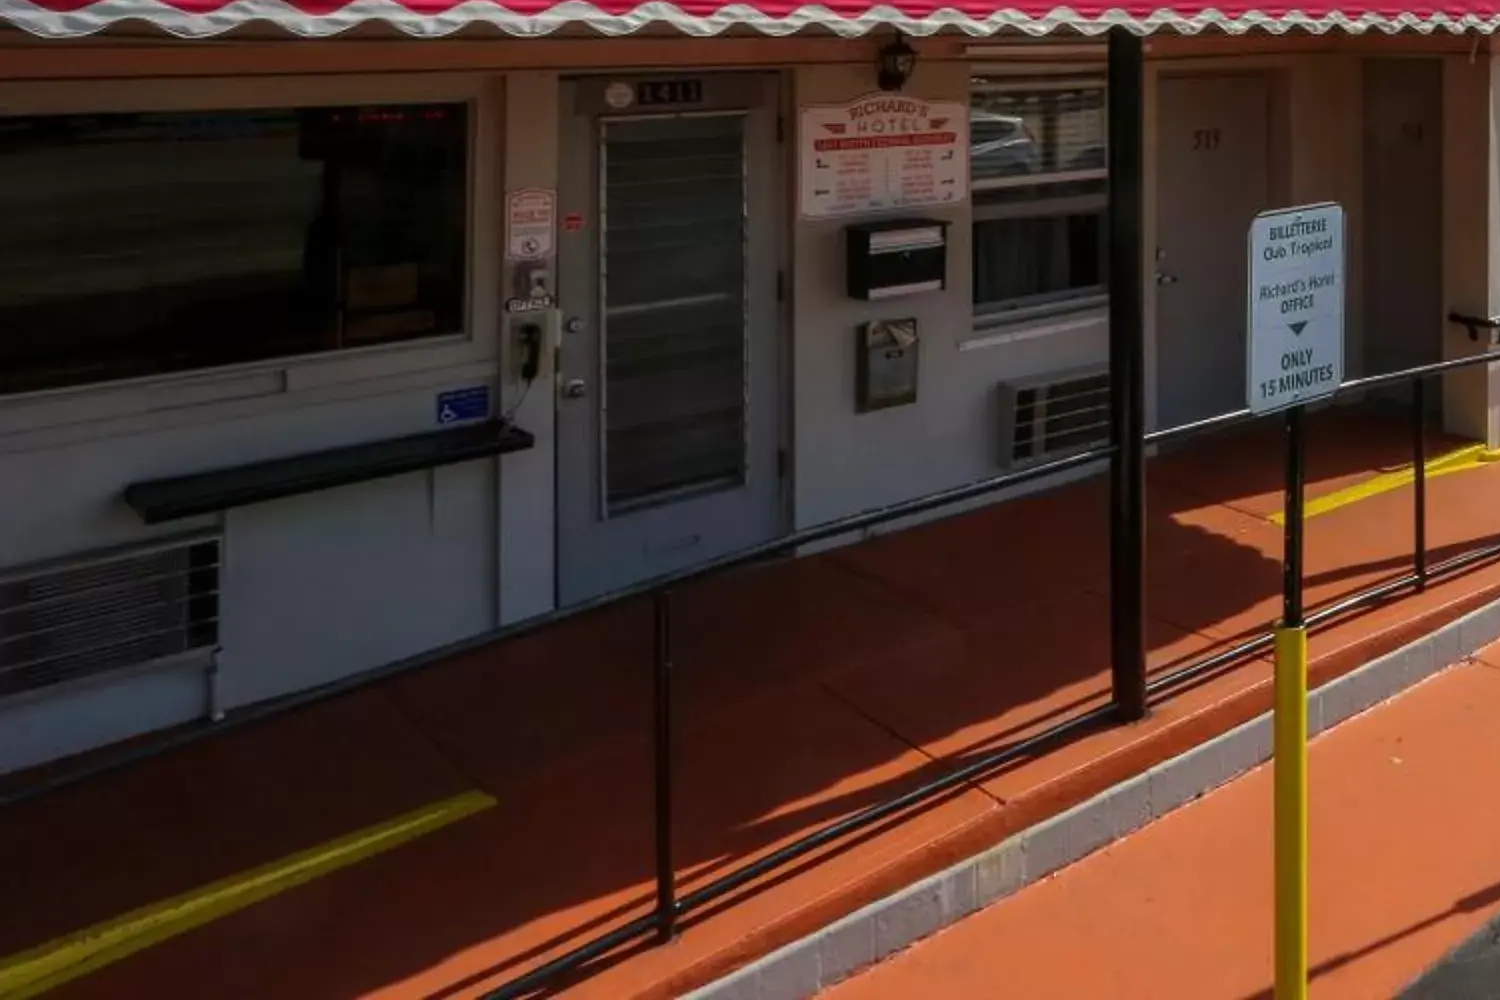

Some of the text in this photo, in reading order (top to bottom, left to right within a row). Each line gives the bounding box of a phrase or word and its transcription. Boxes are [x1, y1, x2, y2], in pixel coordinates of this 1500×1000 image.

[848, 99, 930, 121] RICHARD'S
[857, 117, 923, 133] HOTEL
[1263, 235, 1333, 261] Club Tropical
[1281, 294, 1315, 314] OFFICE
[1281, 347, 1314, 371] ONLY
[1261, 363, 1334, 399] 15 MINUTES
